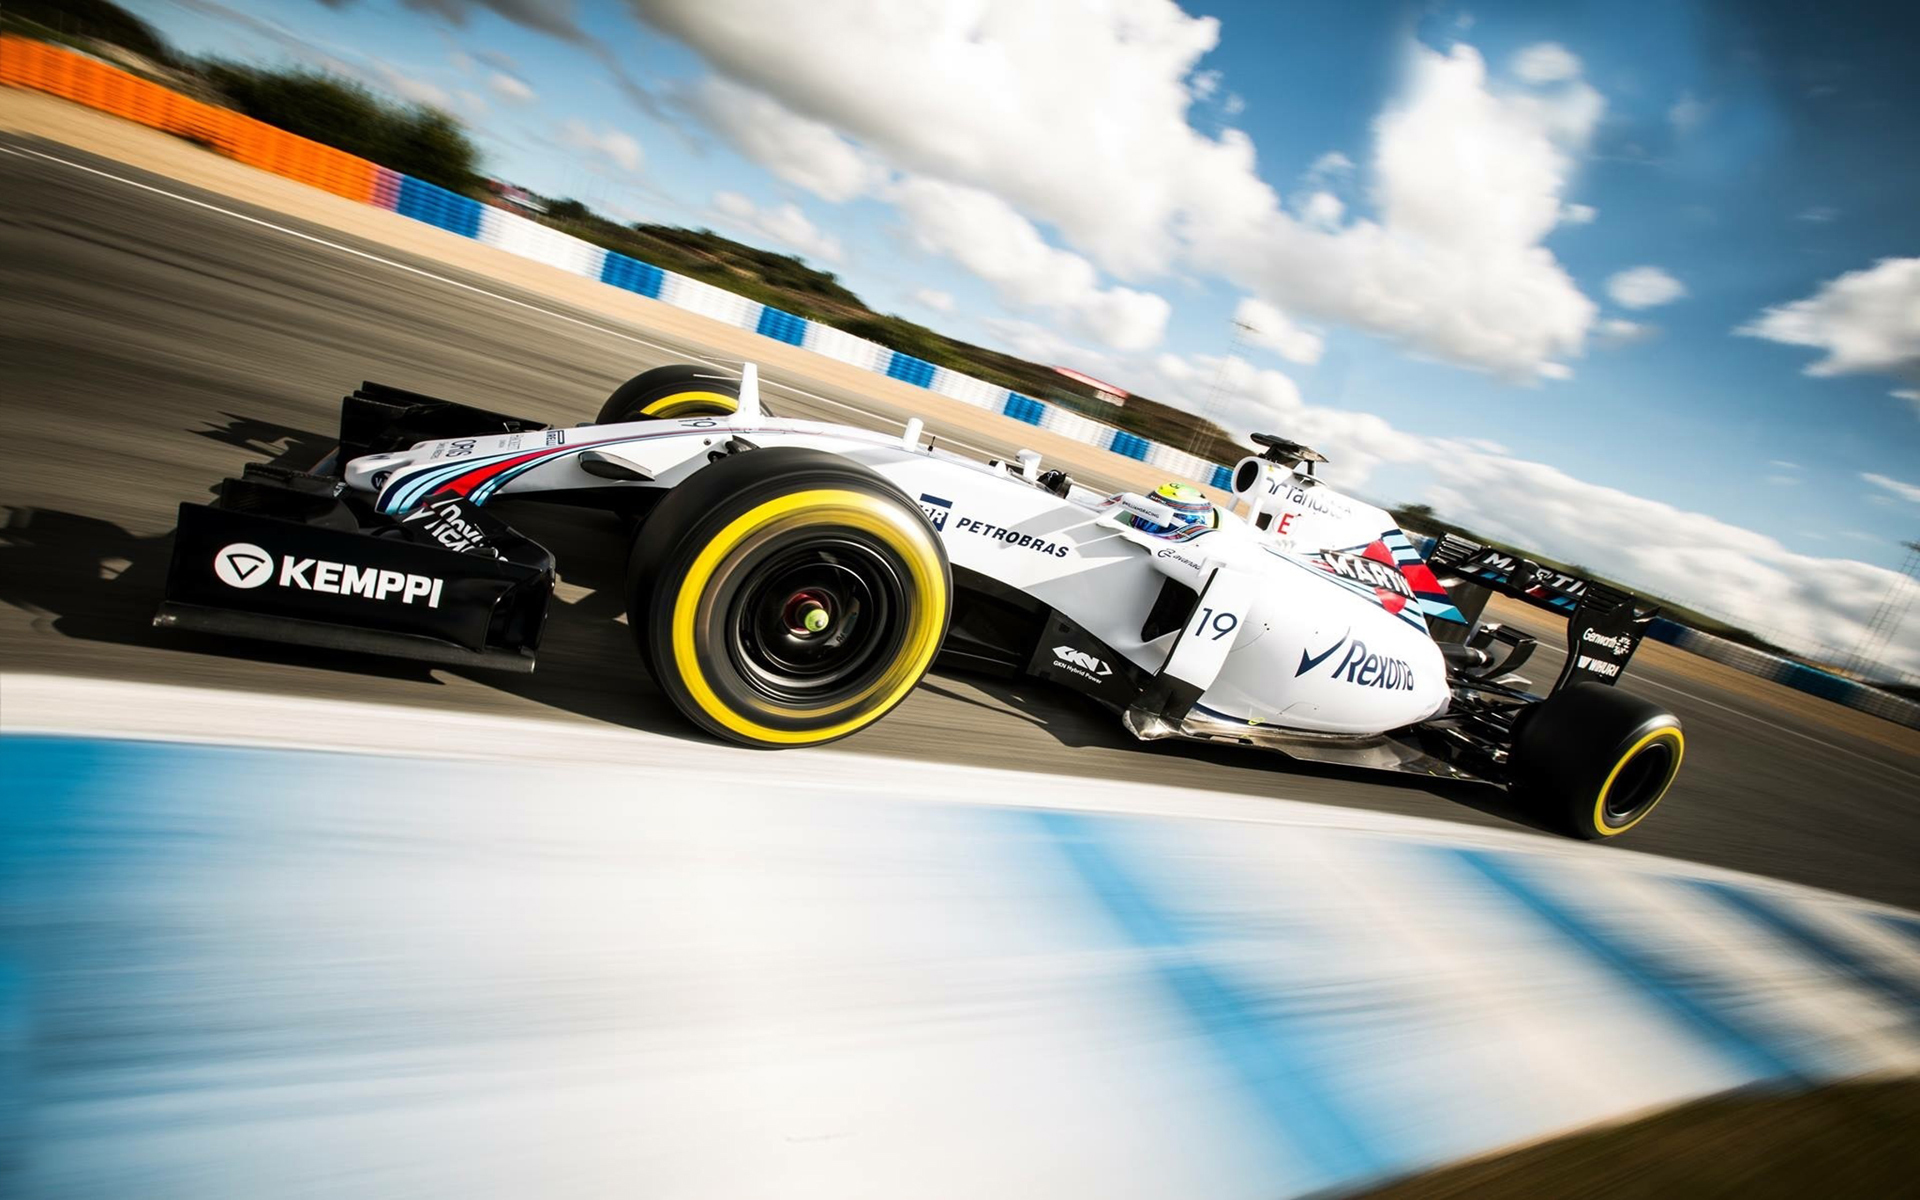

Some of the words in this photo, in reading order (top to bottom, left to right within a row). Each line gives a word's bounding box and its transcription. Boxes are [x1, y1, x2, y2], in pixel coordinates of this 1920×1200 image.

[956, 517, 1070, 558] PETROBRAS
[1277, 513, 1295, 535] E
[279, 555, 444, 609] KEMPPI
[1195, 607, 1238, 641] 19
[1053, 660, 1067, 669] GKN
[1066, 665, 1085, 677] Hybrid
[1084, 673, 1102, 685] Power
[1331, 640, 1415, 691] Rexona
